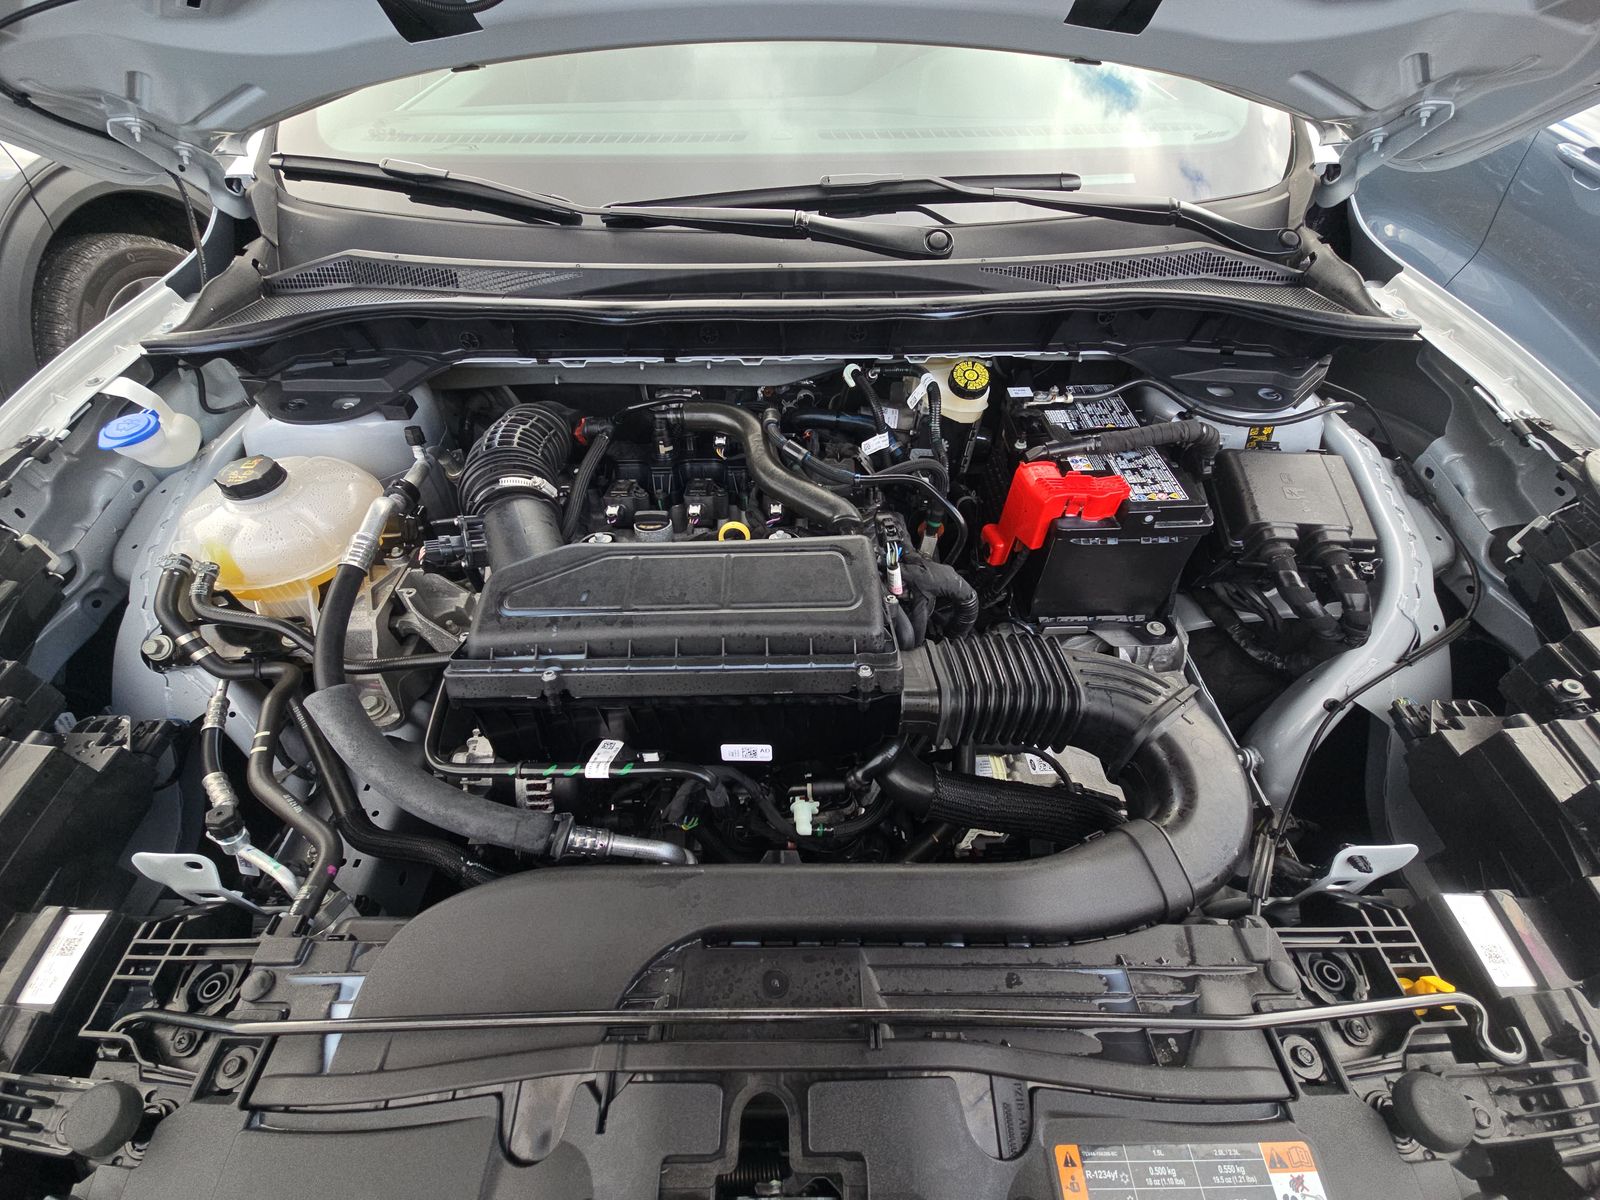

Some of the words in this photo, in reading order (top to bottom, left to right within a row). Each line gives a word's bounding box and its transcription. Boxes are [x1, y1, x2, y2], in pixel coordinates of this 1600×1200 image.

[1085, 1169, 1119, 1181] R-1234yf
[1148, 1166, 1167, 1176] 0.500
[1166, 1166, 1177, 1178] kg
[1217, 1164, 1236, 1174] 0.550
[1235, 1164, 1246, 1175] kg
